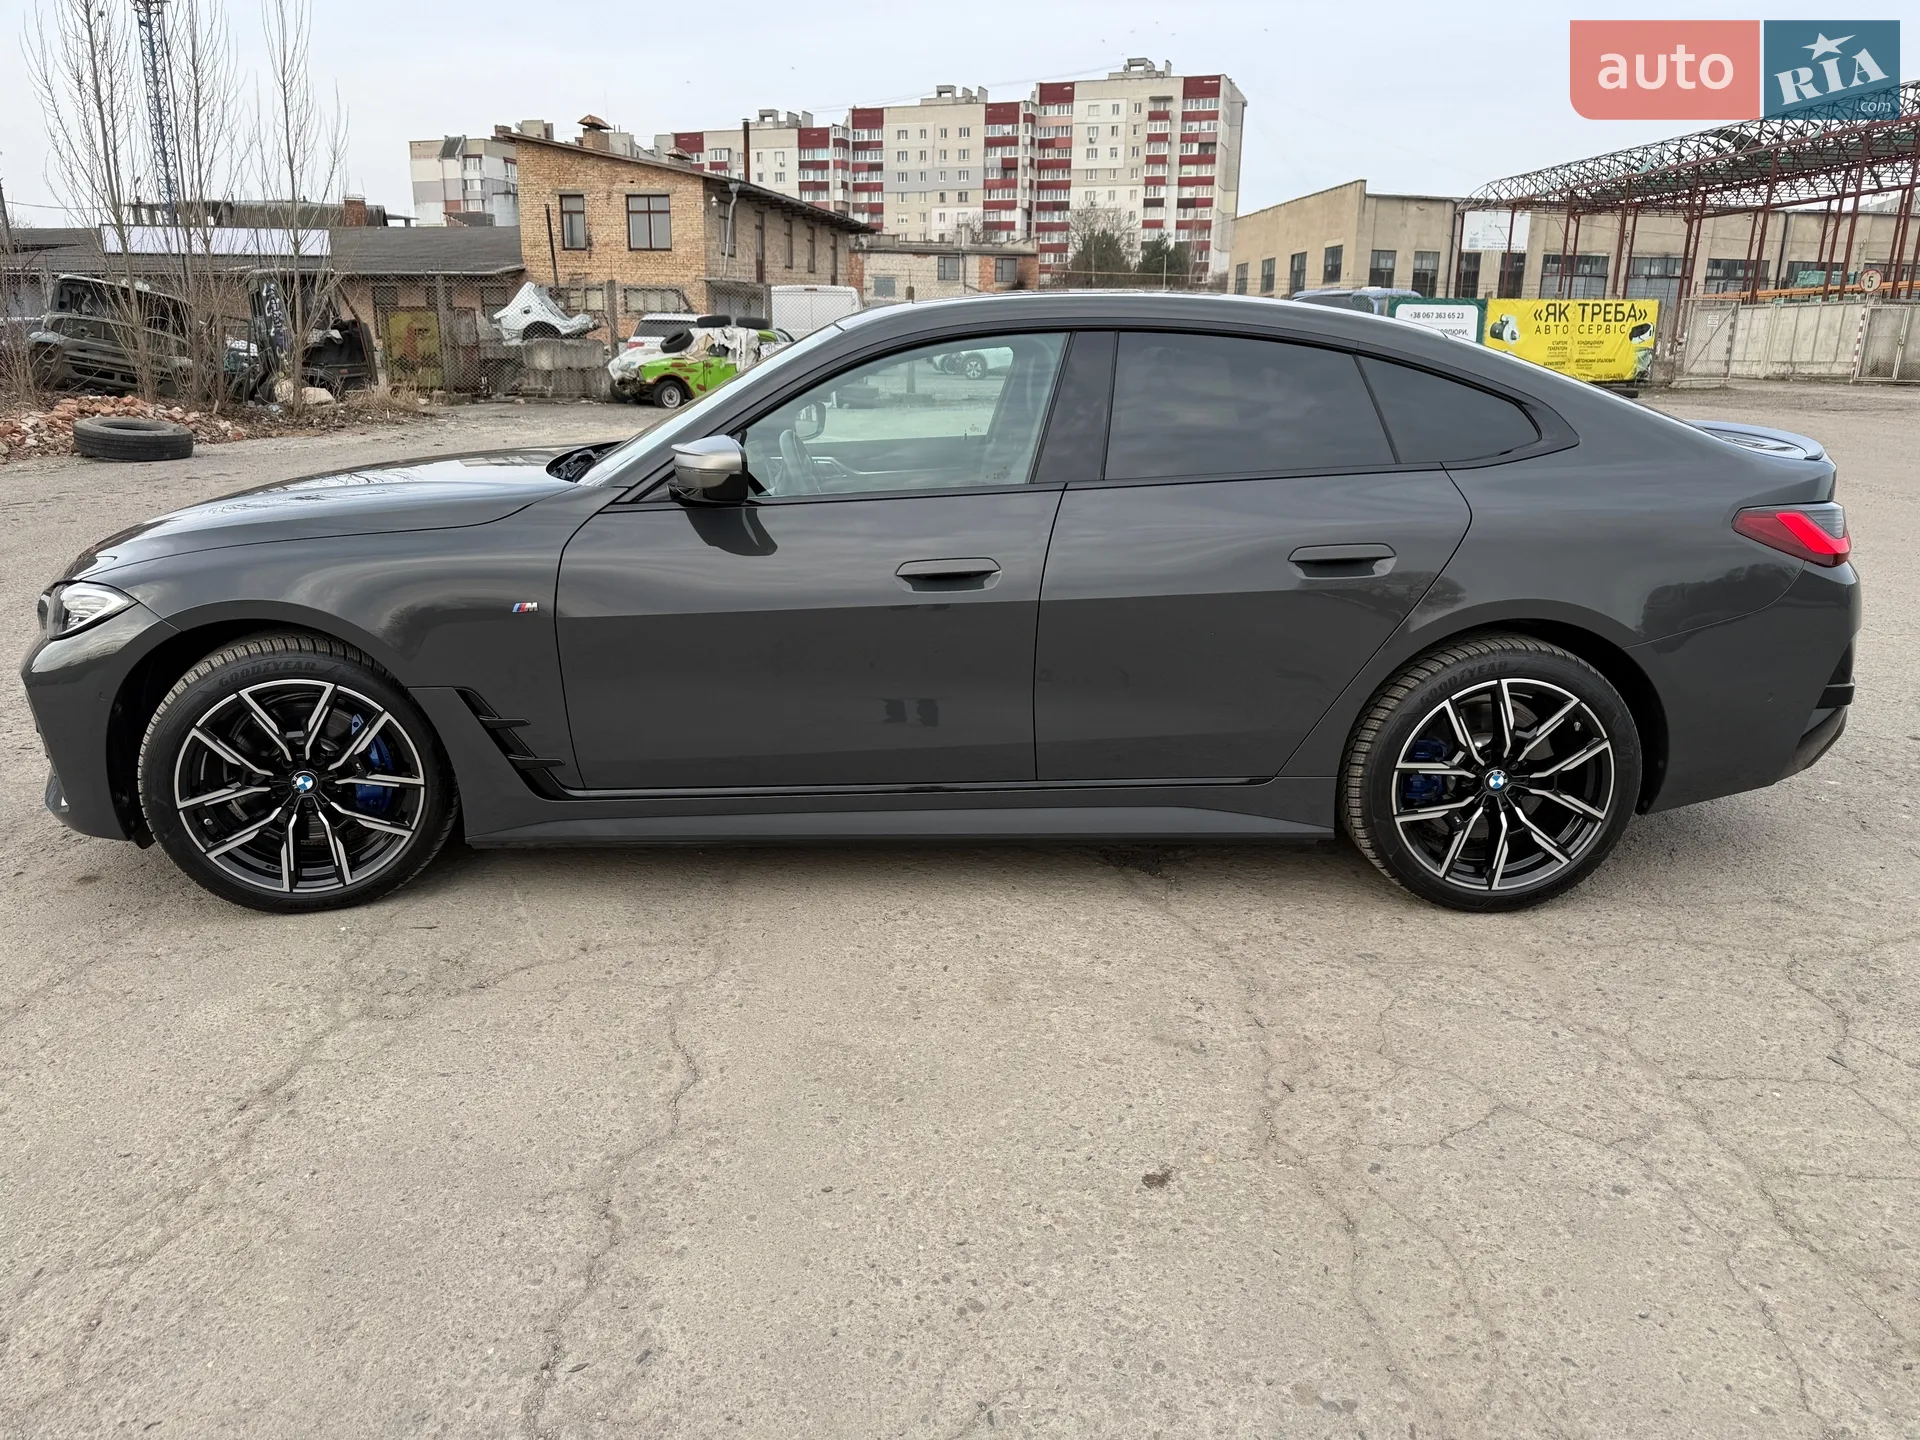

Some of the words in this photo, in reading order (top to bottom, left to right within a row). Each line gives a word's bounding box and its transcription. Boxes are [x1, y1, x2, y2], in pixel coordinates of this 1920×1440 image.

[1867, 275, 1874, 288] 5
[1533, 303, 1570, 322] «ЯК
[1578, 303, 1647, 322] ТРЕБА»
[1534, 324, 1569, 334] АВТО
[1578, 324, 1626, 334] СЕРВІС
[218, 661, 317, 687] GOODYEAR
[1419, 661, 1508, 705] GOODYEAR
